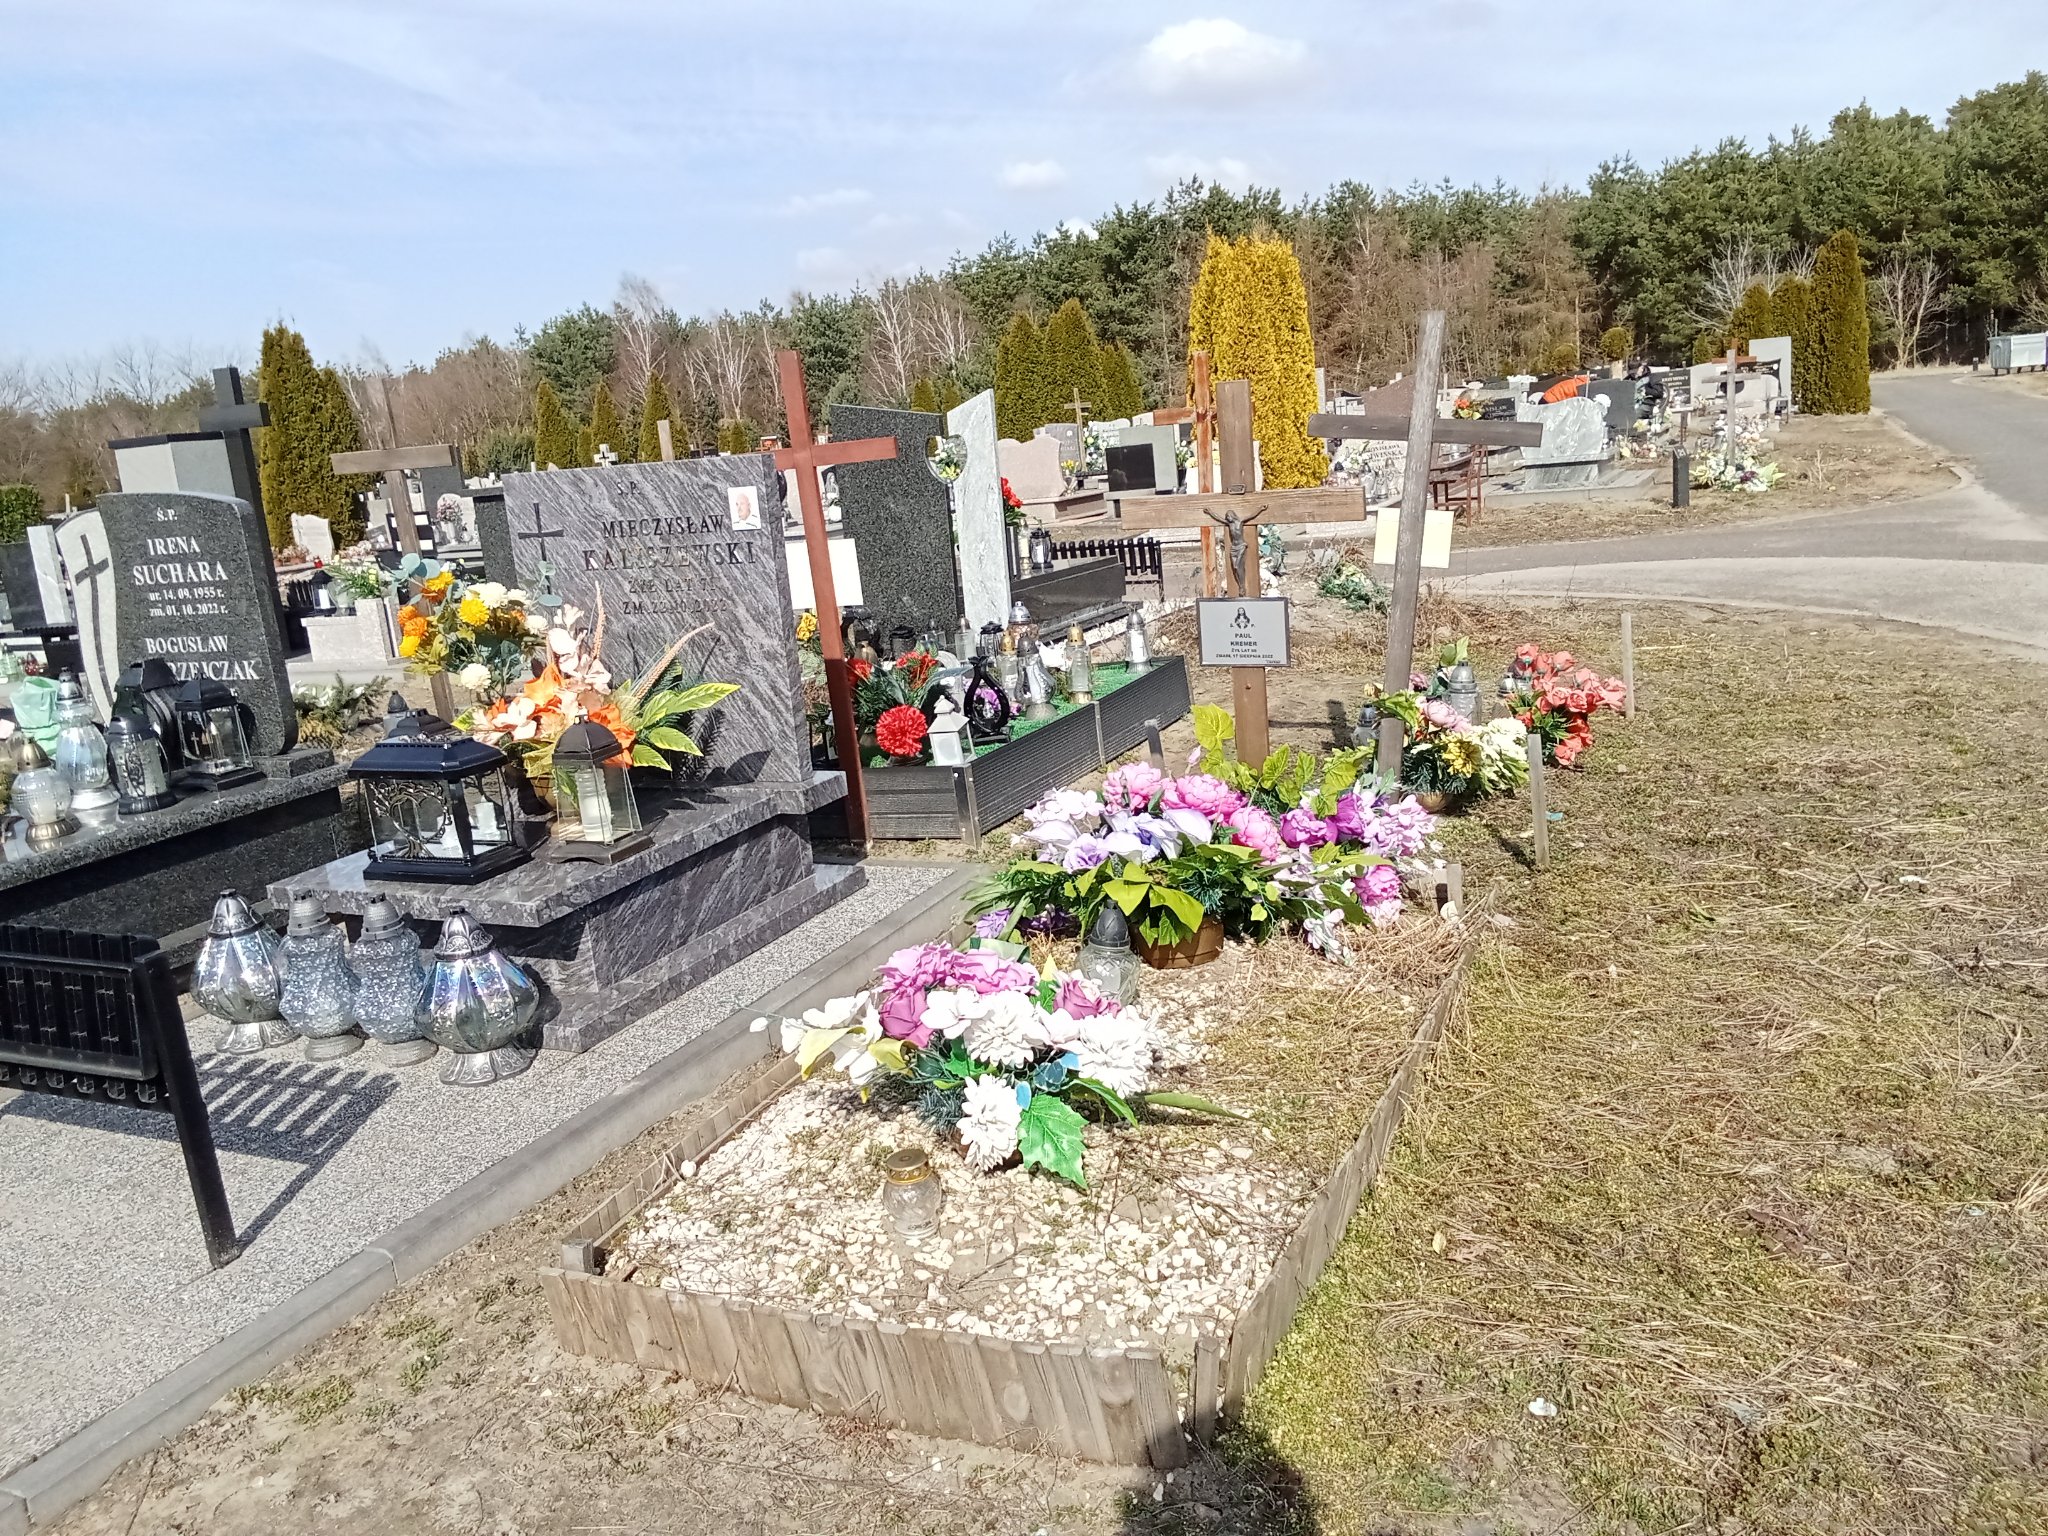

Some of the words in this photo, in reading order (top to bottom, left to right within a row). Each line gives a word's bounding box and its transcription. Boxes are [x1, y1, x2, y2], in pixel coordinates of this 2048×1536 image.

[602, 514, 725, 539] MIECZYSŁAW
[147, 535, 200, 555] IRENA
[582, 541, 756, 572] KALISZEWSKI
[132, 561, 228, 585] SUCHARA
[149, 592, 161, 600] ur.
[163, 589, 177, 600] 14.
[177, 588, 192, 599] 09.
[193, 587, 216, 599] 1955
[149, 608, 166, 616] zm.
[166, 604, 180, 616] 01.
[182, 603, 196, 615] 10.
[196, 603, 219, 615] 2022
[166, 660, 260, 681] RZEJCZAK
